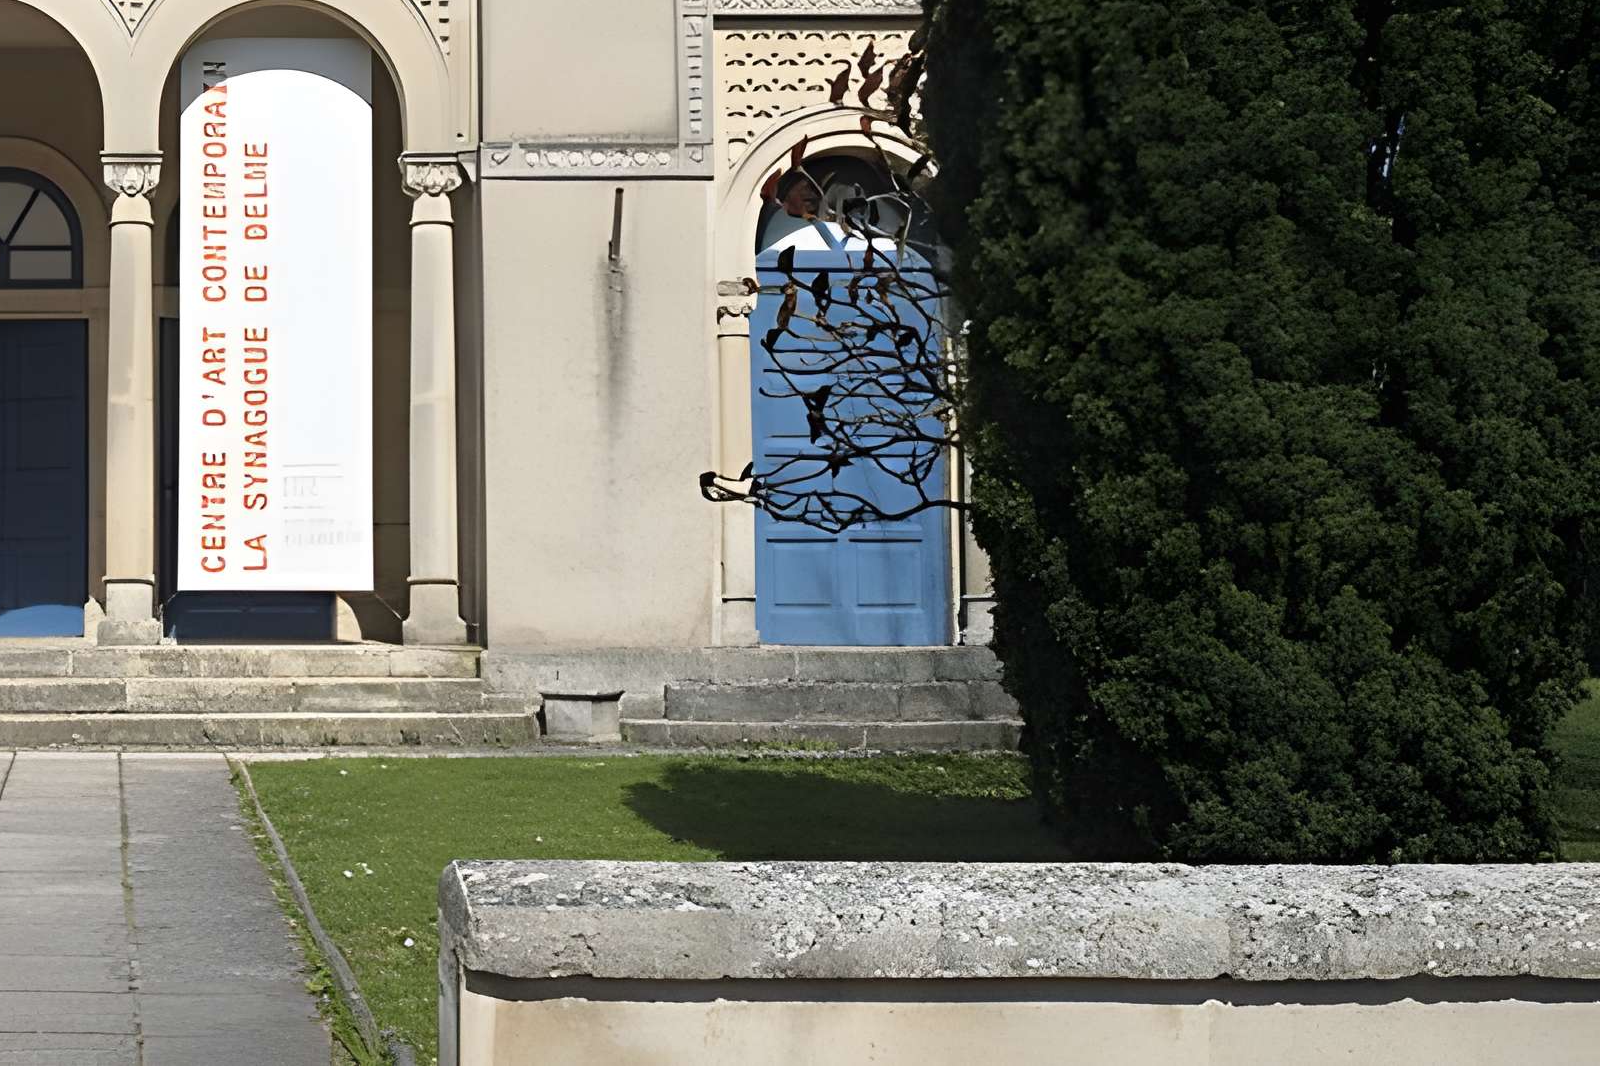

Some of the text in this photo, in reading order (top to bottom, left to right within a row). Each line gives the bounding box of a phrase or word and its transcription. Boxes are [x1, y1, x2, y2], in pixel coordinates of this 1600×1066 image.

[201, 326, 227, 427] D'ART
[242, 142, 268, 571] LA SYNAGOGUE DE DELME
[201, 452, 227, 574] CENTRE
